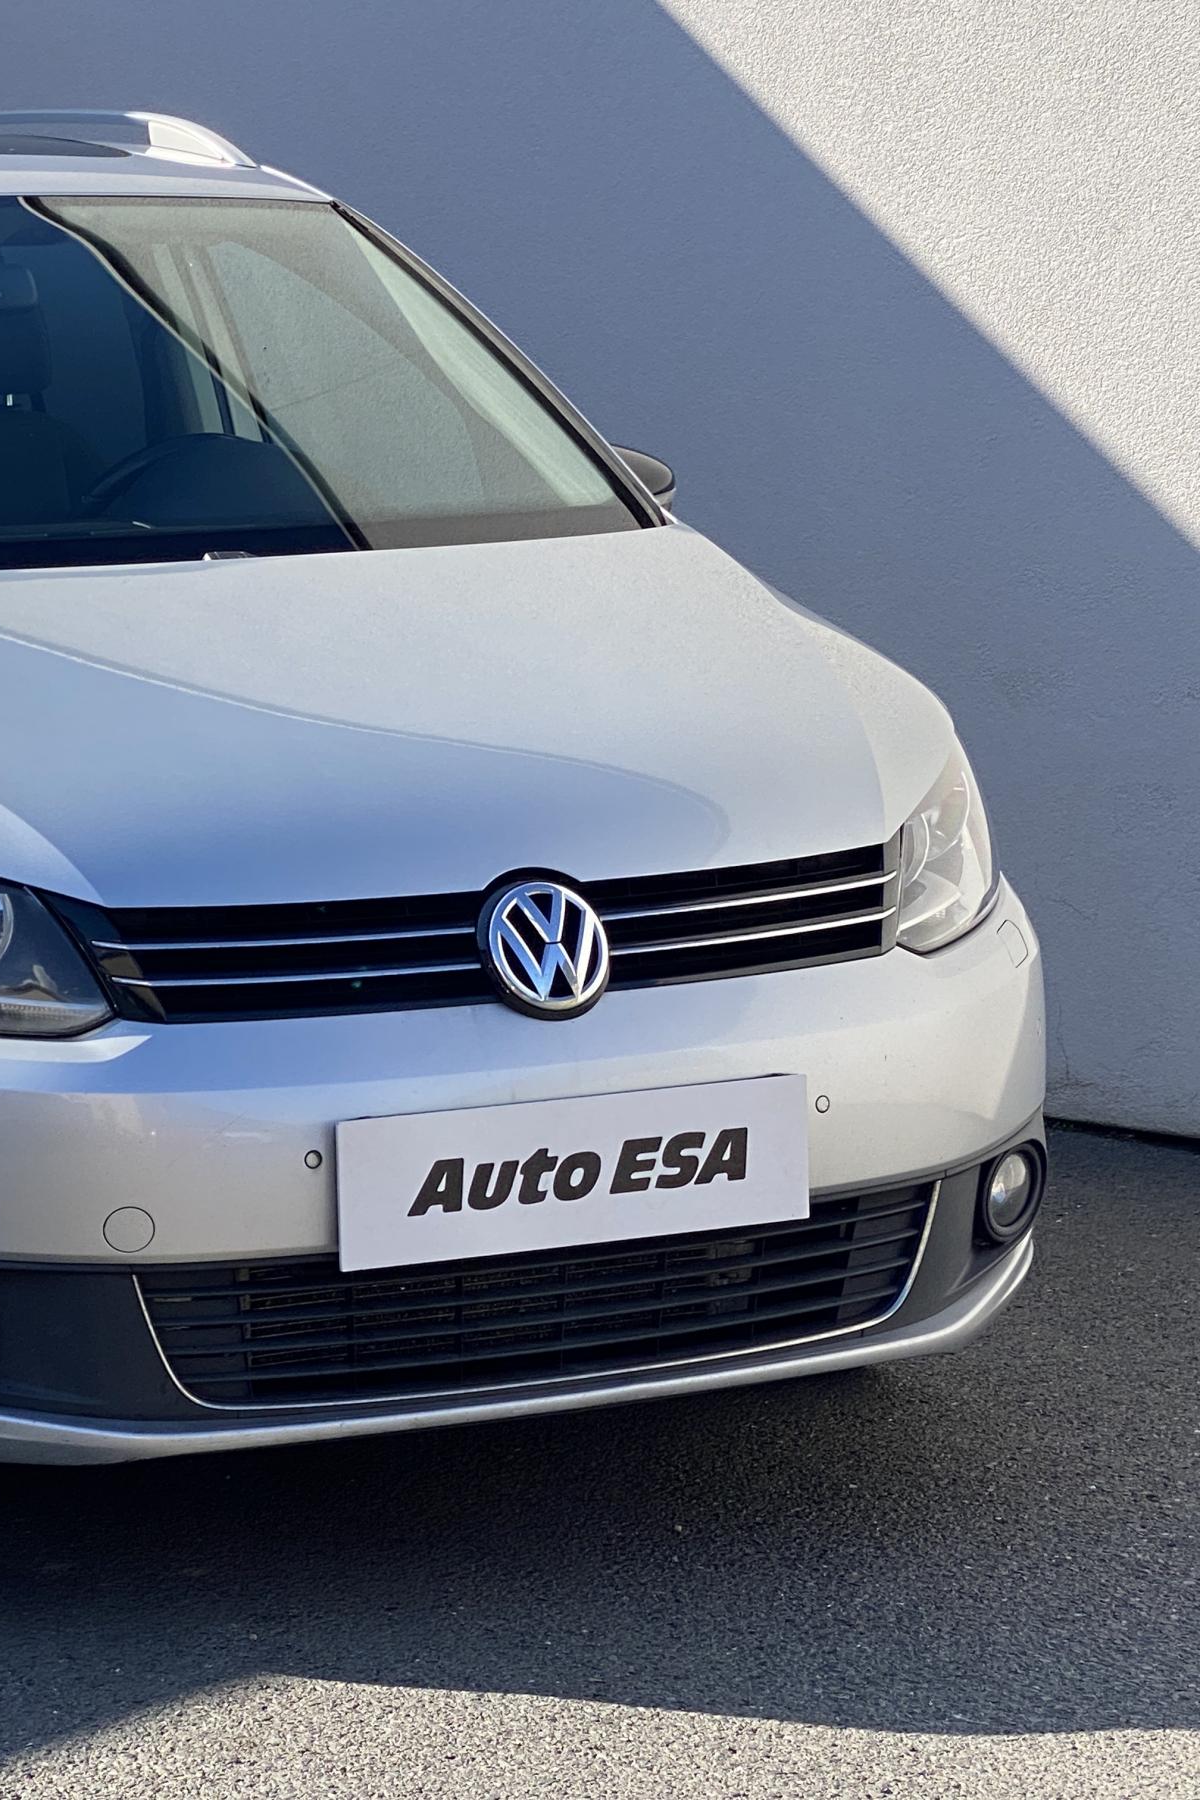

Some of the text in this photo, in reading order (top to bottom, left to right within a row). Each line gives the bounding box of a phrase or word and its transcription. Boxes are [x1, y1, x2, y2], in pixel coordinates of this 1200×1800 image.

[491, 883, 606, 1006] VW
[407, 1127, 748, 1216] Auto ESA
